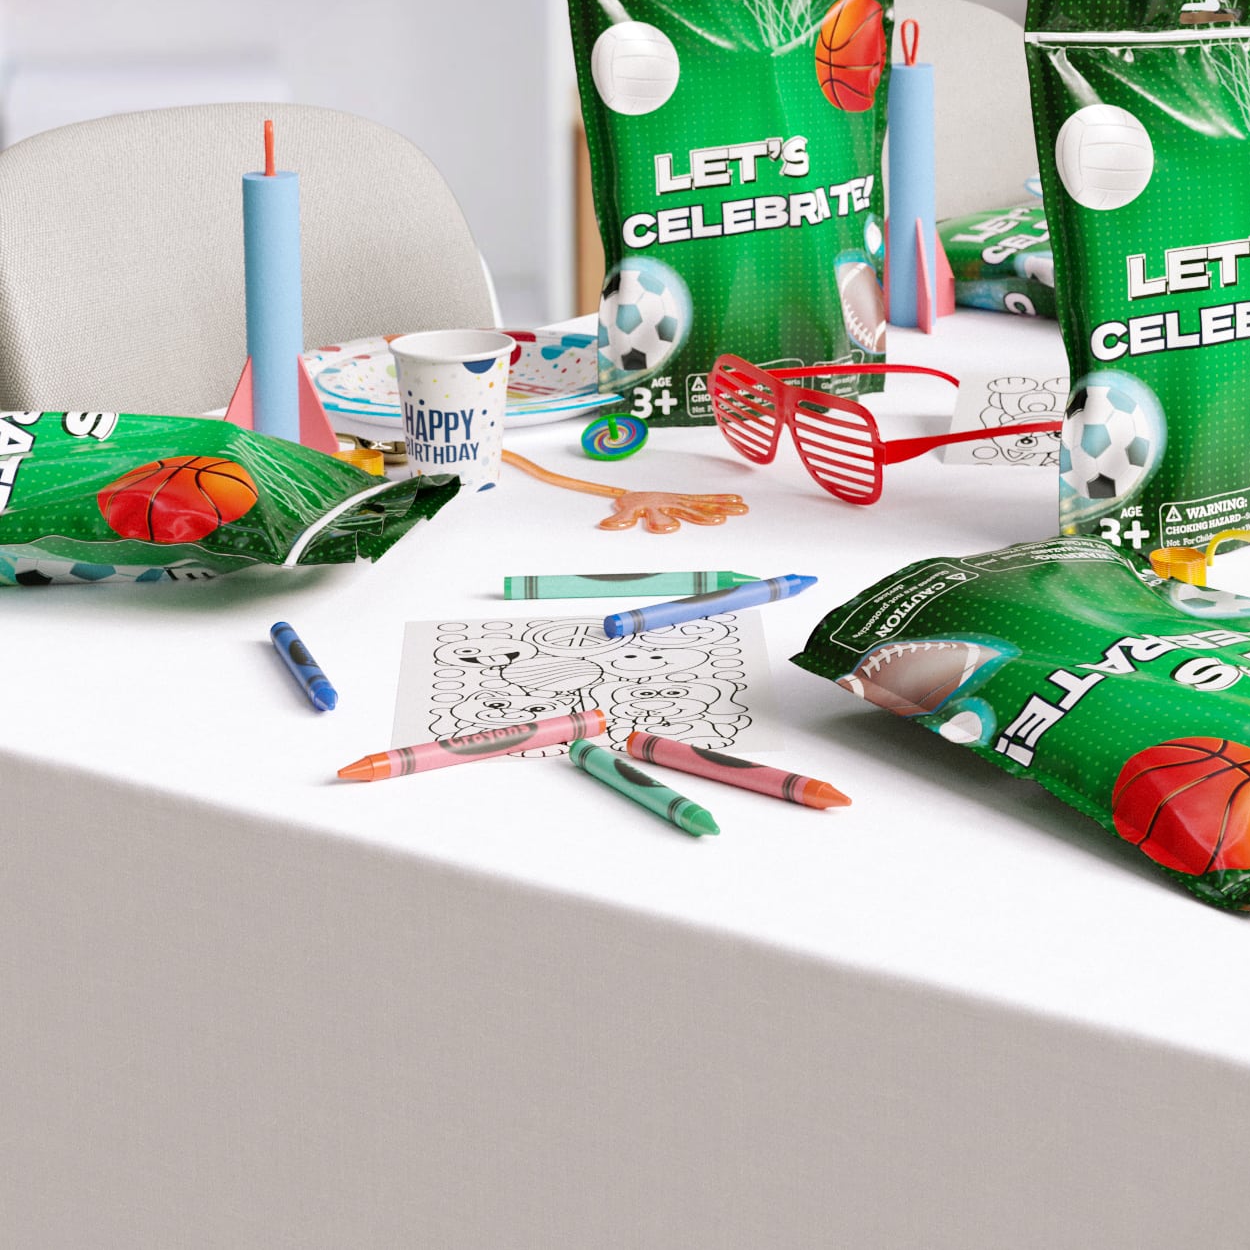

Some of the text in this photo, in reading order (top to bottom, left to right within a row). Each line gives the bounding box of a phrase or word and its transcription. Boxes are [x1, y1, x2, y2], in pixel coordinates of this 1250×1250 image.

[654, 135, 809, 196] LET'S
[622, 174, 874, 248] CELEBRATE!
[651, 376, 673, 389] AGE
[630, 387, 678, 420] 3+
[404, 402, 475, 443] HAPPY
[405, 436, 480, 465] BIRTHDAY
[1120, 505, 1144, 519] AGE
[1185, 496, 1248, 520] WARNING:
[1099, 517, 1151, 550] 3+
[1165, 521, 1208, 536] CHOKING
[873, 584, 906, 604] devices
[874, 581, 946, 638] CAUTION
[851, 601, 890, 639] protective
